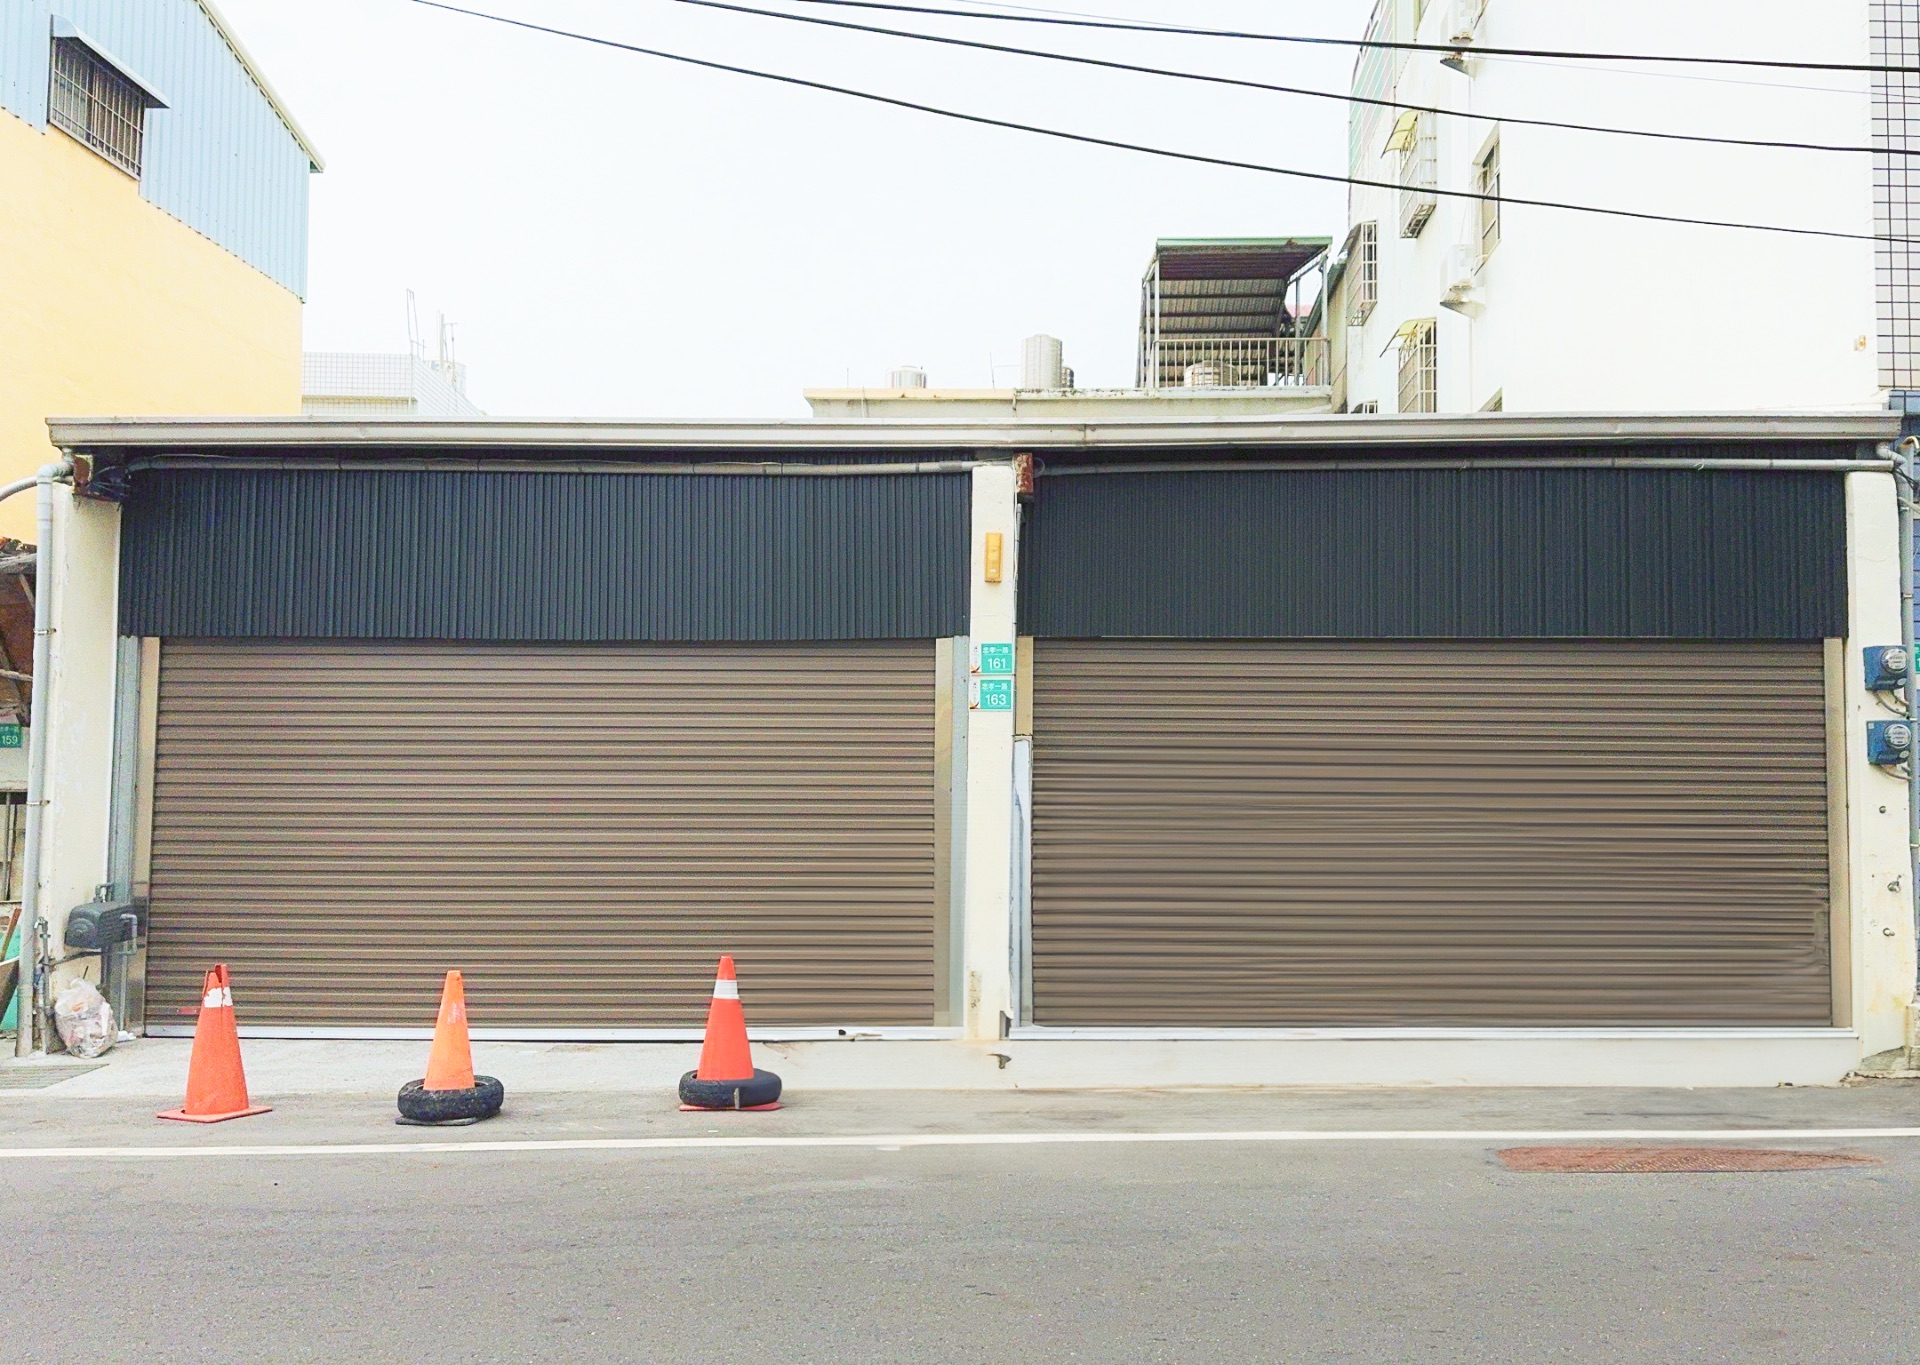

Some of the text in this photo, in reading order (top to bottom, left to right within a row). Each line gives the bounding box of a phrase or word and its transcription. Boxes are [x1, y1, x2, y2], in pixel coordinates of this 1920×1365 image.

[987, 658, 1006, 669] 161
[986, 694, 1006, 705] 163
[2, 735, 17, 744] 159
